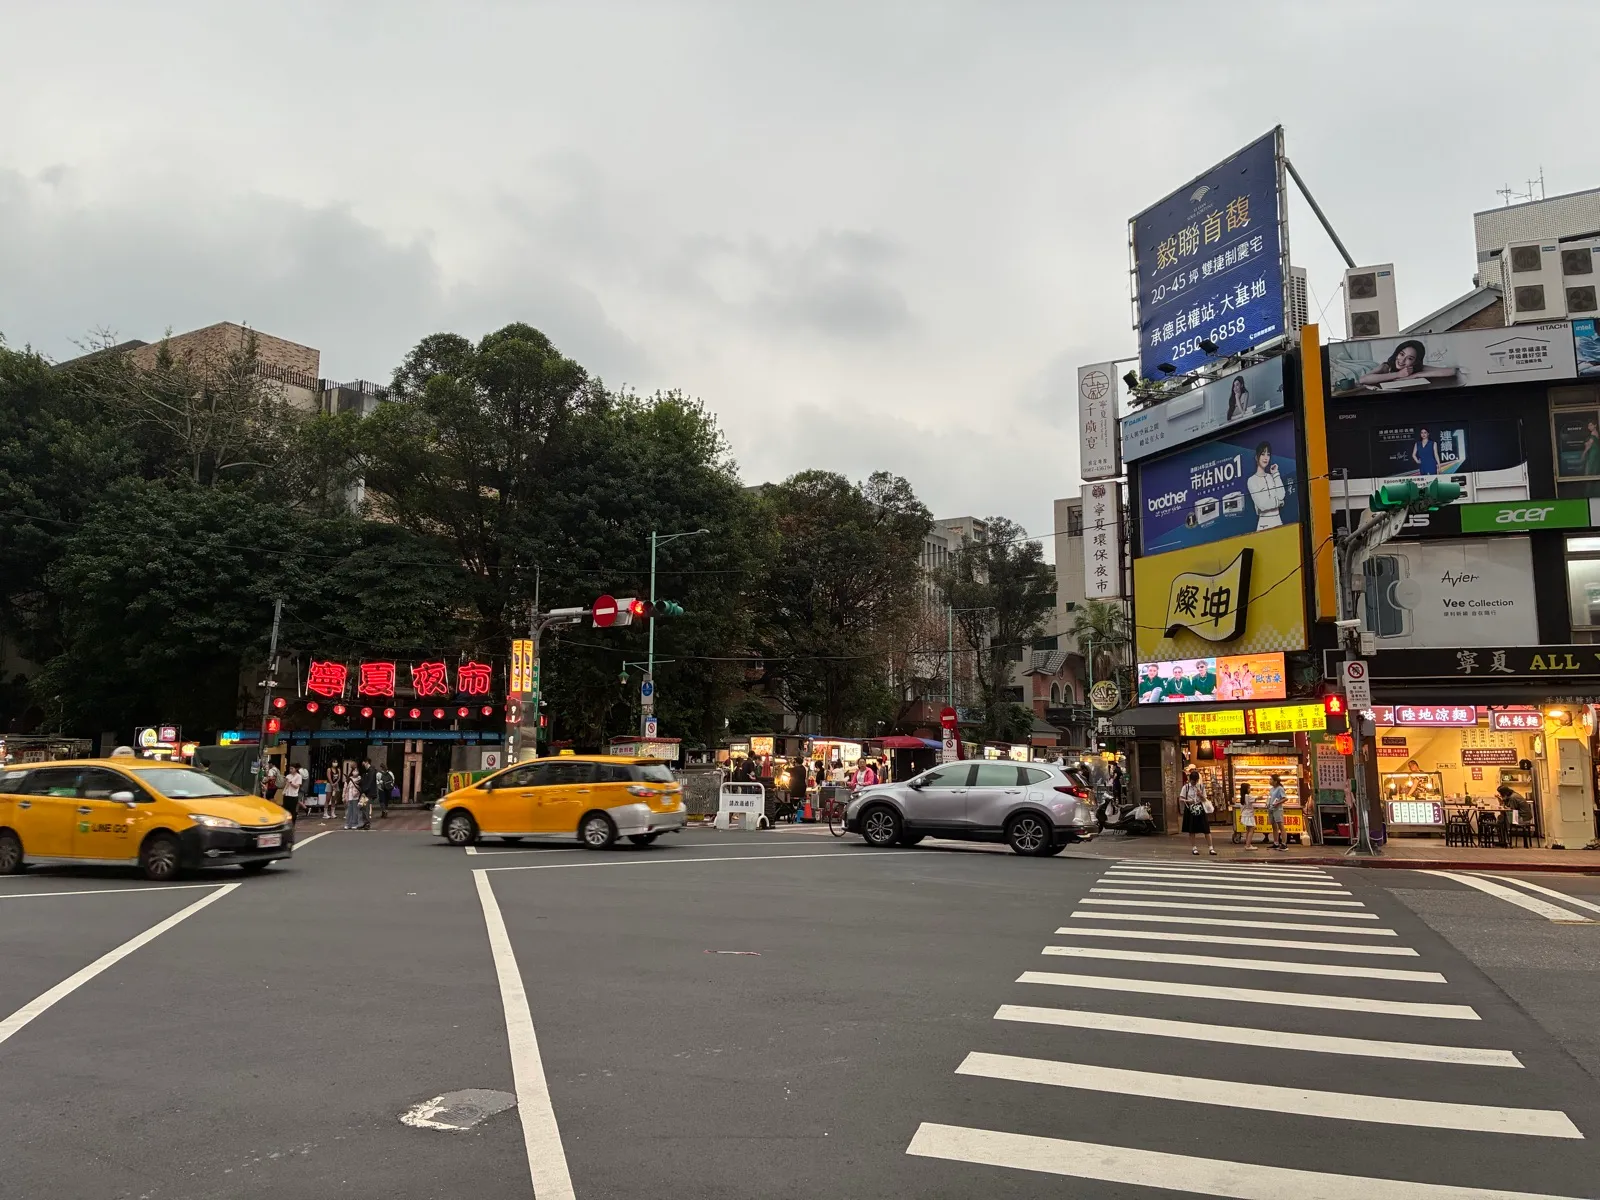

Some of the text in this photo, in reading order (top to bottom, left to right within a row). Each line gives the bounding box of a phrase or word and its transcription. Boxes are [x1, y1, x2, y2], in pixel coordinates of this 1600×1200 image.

[1157, 195, 1251, 270] 毅聯首馥
[1151, 235, 1263, 304] 20-45 坪 雙捷制震宅
[1150, 278, 1267, 346] 承德民權站 大基地
[1536, 323, 1568, 331] HITACHI
[1576, 323, 1592, 331] intel
[1171, 316, 1245, 361] 2550-6858
[1129, 414, 1148, 426] DAIKIN
[1148, 490, 1188, 511] brother
[1161, 508, 1171, 518] your
[1495, 507, 1554, 523] acer
[1093, 503, 1108, 593] 寧夏環保夜市
[1441, 570, 1480, 588] Avier
[1174, 584, 1231, 627] 燦坤
[1442, 598, 1514, 607] Vee Collection
[1456, 650, 1516, 674] 寧夏
[1529, 654, 1581, 670] ALL
[308, 661, 492, 697] 寧夏夜市
[1402, 707, 1468, 721] 陸地涼麵
[1499, 715, 1539, 726] 熱乾麵
[91, 823, 112, 832] LINE
